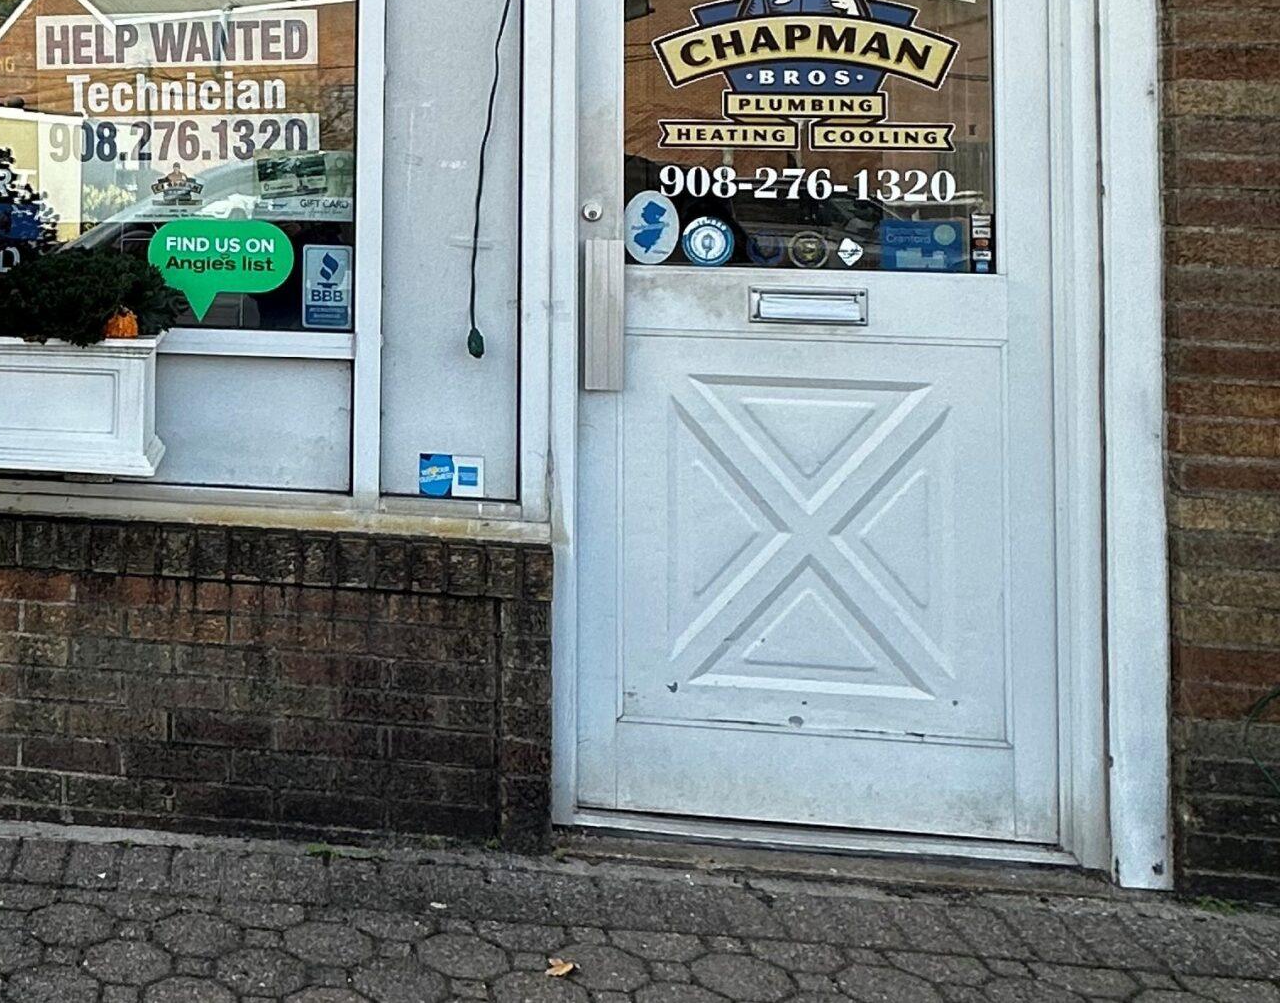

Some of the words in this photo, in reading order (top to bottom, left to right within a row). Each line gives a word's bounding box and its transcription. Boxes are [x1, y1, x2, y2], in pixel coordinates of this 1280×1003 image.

[45, 24, 138, 64] HELP
[150, 19, 309, 63] WANTED
[679, 24, 934, 70] CHAPMAN
[759, 70, 851, 86] BROS
[66, 71, 287, 112] Technician
[738, 98, 873, 113] PLUMBING
[49, 118, 309, 163] 908.276.1320
[676, 127, 786, 143] HEATING
[822, 129, 938, 145] COOLING
[658, 166, 956, 202] 908-276-1320
[165, 236, 210, 253] FIND
[215, 237, 240, 253] US
[245, 238, 275, 253] ON
[242, 256, 275, 272] list
[310, 289, 343, 303] BBB
